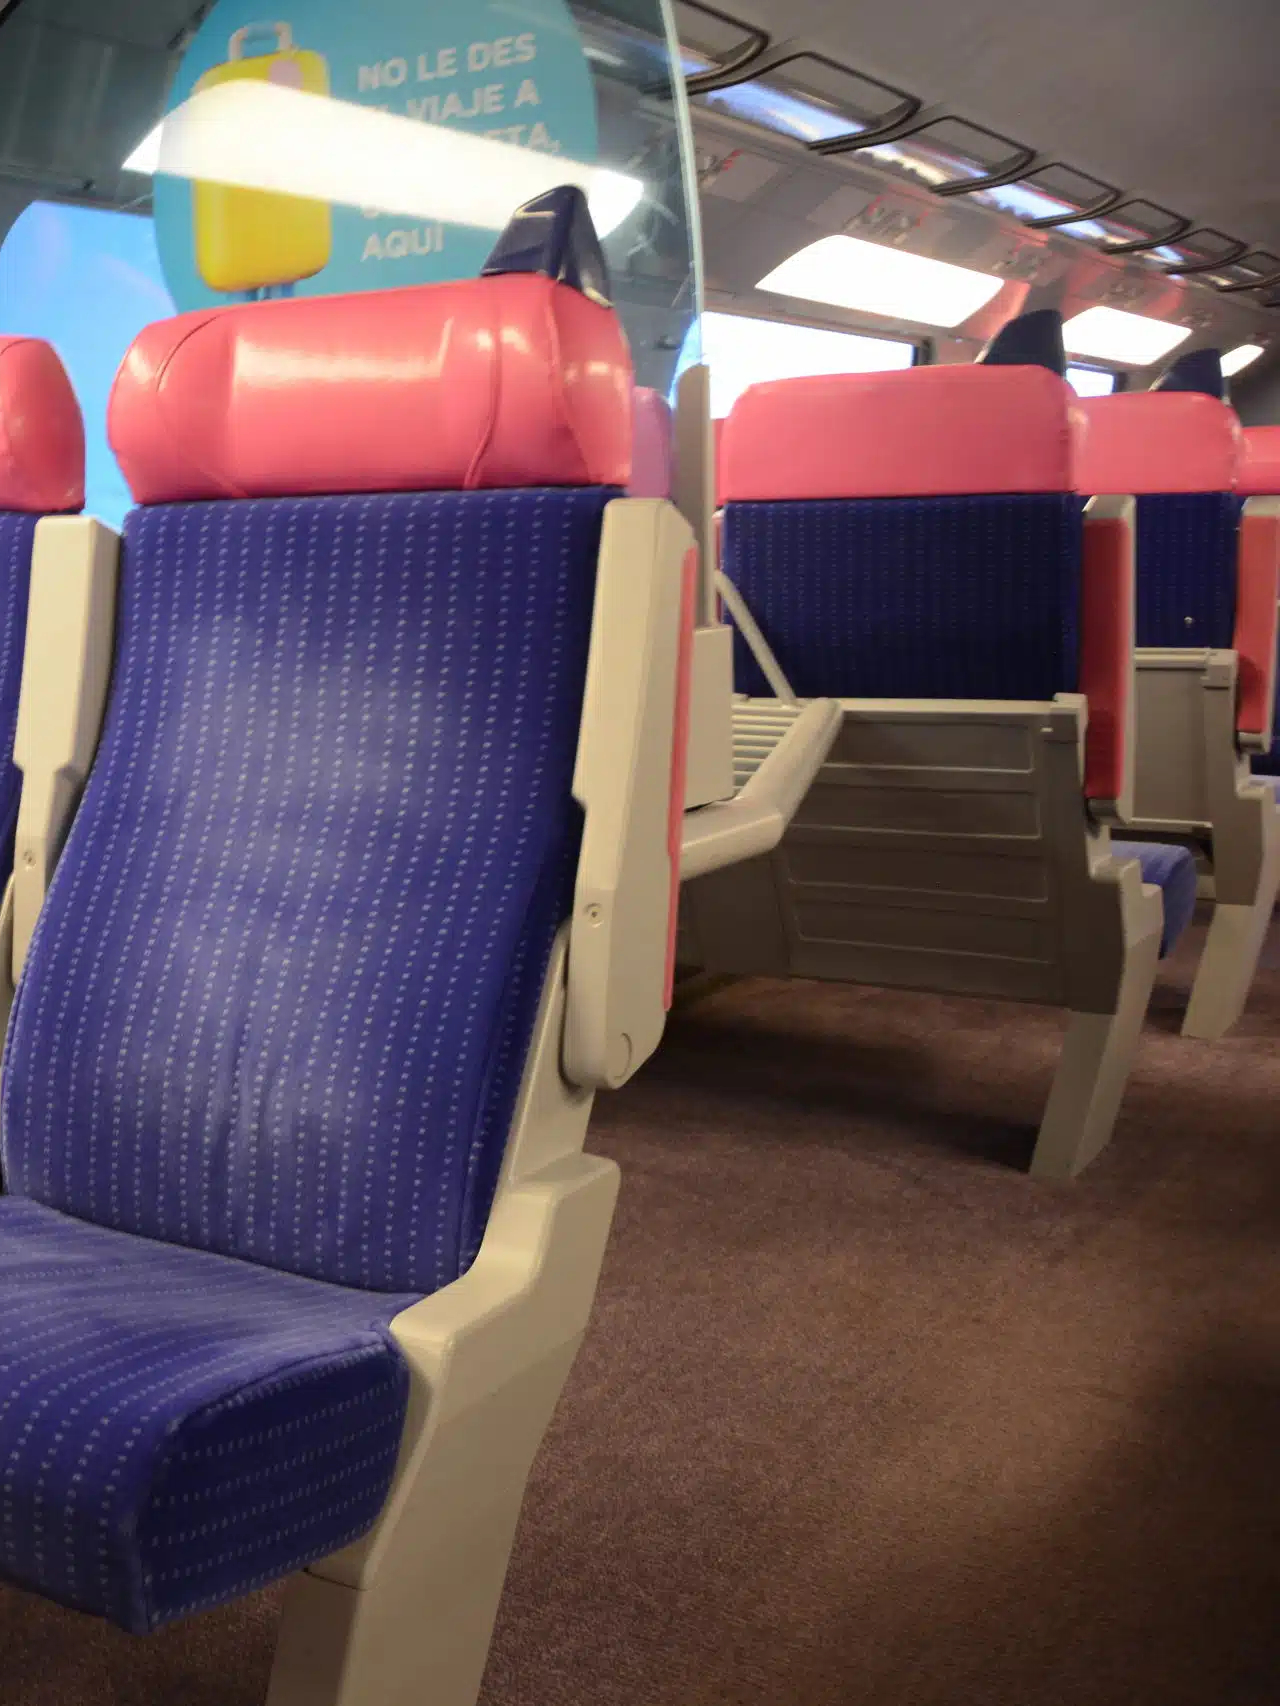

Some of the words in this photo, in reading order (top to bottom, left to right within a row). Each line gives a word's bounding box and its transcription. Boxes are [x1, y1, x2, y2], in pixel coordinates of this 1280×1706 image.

[358, 57, 408, 92] NO
[417, 48, 457, 82] LE
[468, 32, 536, 72] DES
[406, 84, 504, 123] VIAJE
[514, 79, 541, 108] A
